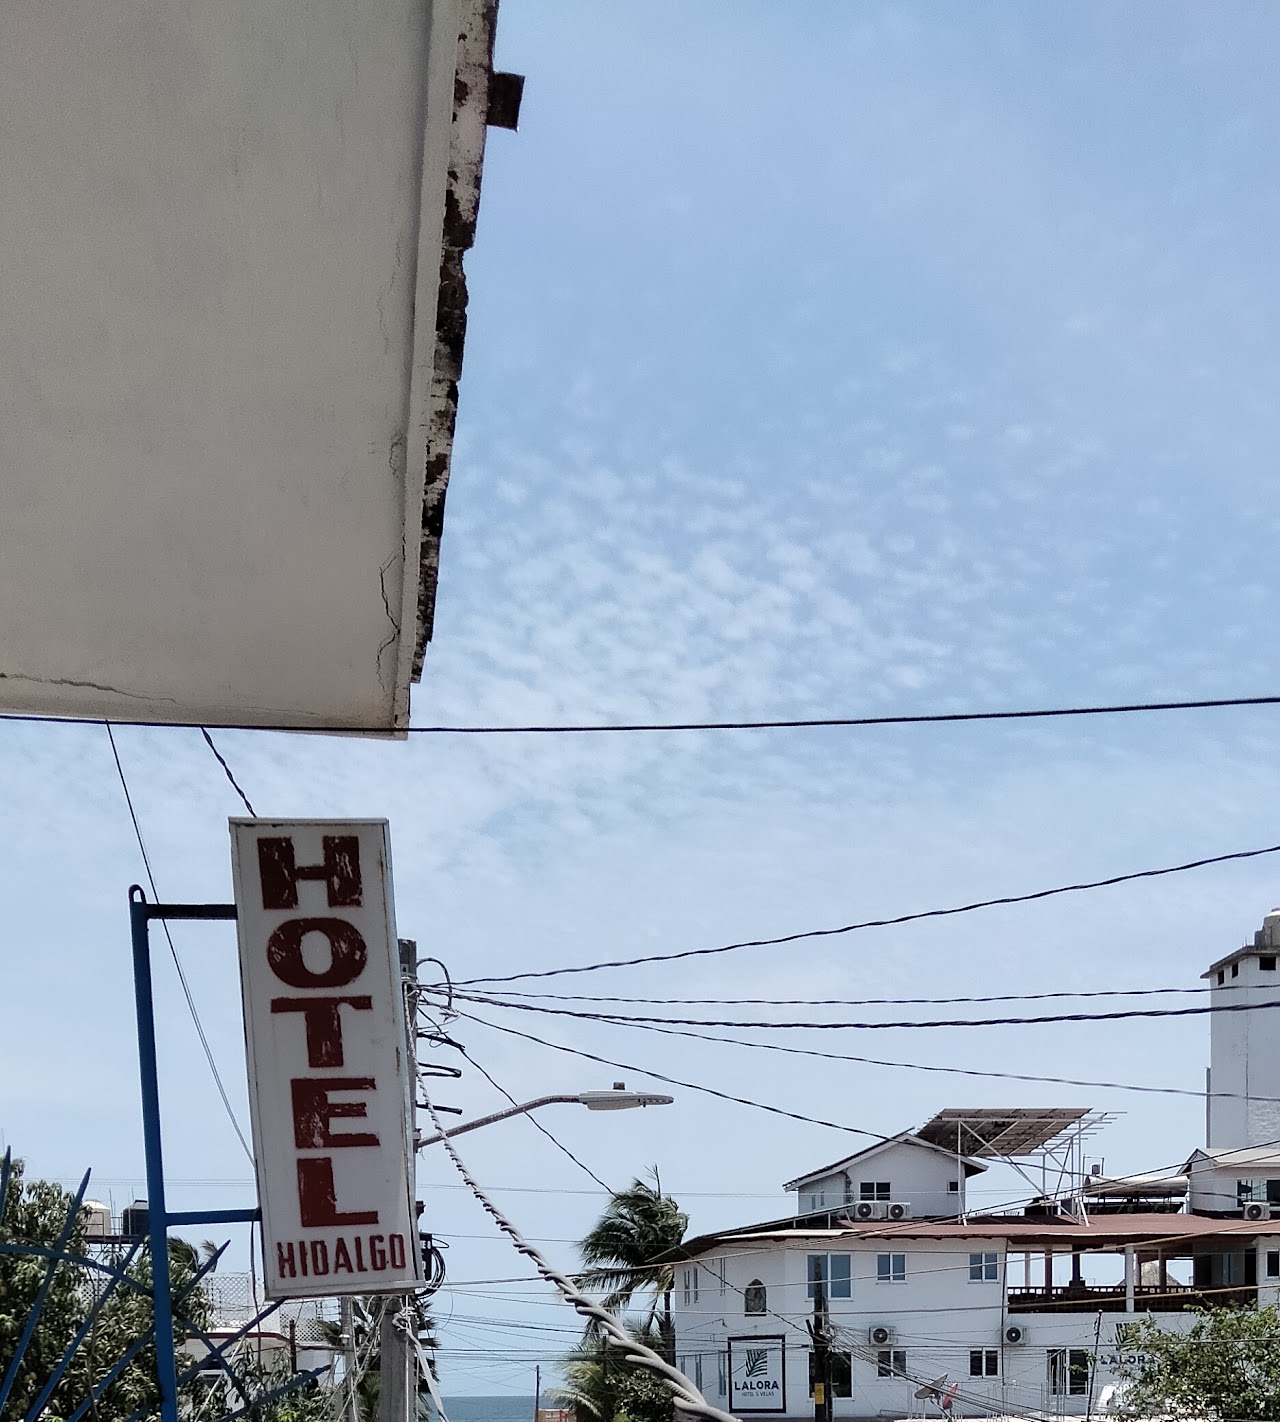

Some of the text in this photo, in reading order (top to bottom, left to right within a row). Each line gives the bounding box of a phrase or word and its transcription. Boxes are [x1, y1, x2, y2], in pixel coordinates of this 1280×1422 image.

[257, 835, 381, 1228] HOTEL
[277, 1234, 406, 1279] HIDALGO
[734, 1381, 779, 1390] LALORA
